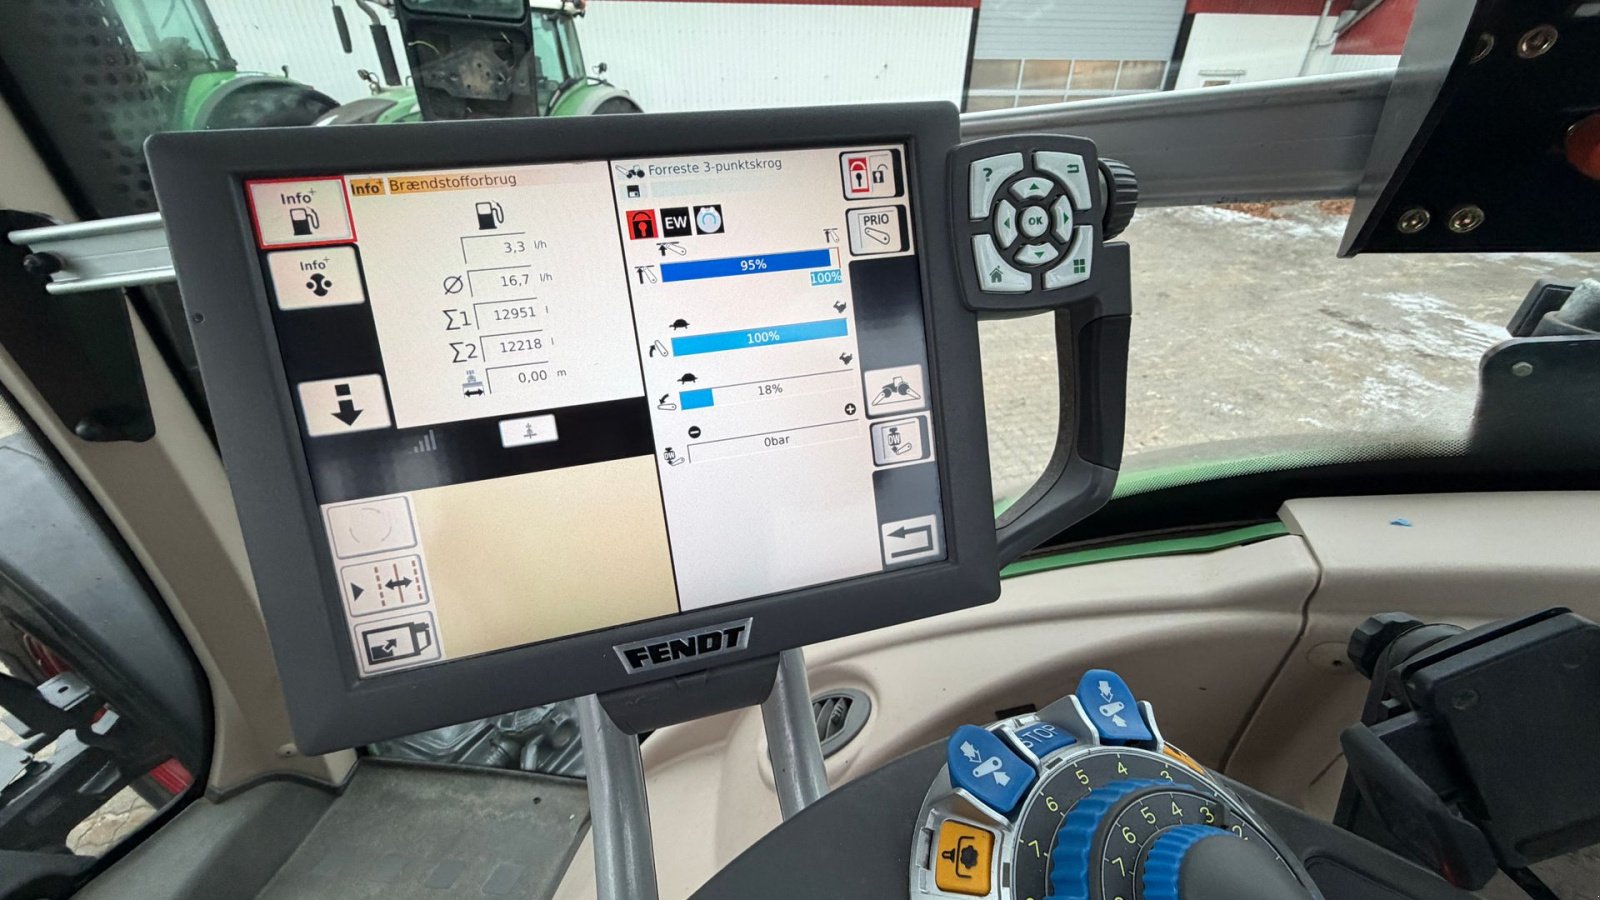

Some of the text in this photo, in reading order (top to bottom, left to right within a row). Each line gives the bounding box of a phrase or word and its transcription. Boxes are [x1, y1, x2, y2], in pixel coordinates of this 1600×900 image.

[649, 157, 782, 176] Forreste 3-punktskrog
[389, 173, 517, 192] Brændstofforbrug
[664, 214, 687, 229] EW
[863, 213, 889, 225] PRIO
[1028, 216, 1043, 226] OK
[504, 239, 547, 254] 3,3 l/h
[740, 259, 767, 270] 95%
[500, 274, 529, 288] 16,7
[539, 272, 553, 283] l/h
[810, 271, 842, 285] 100%
[494, 306, 536, 321] 12951
[747, 331, 780, 344] 100%
[500, 338, 542, 353] 12218
[518, 369, 567, 384] 0,00 m
[757, 384, 783, 396] 18%
[763, 435, 790, 447] 0bar
[624, 625, 746, 668] FENDT
[1117, 761, 1128, 776] 4
[1160, 770, 1173, 782] 3
[1075, 770, 1090, 785] 5
[1045, 797, 1059, 812] 6
[1170, 802, 1183, 817] 4
[1141, 806, 1156, 824] 5
[1200, 807, 1215, 823] 3
[1122, 827, 1136, 844] 6
[1028, 840, 1041, 858] 7
[1111, 857, 1126, 877] 7
